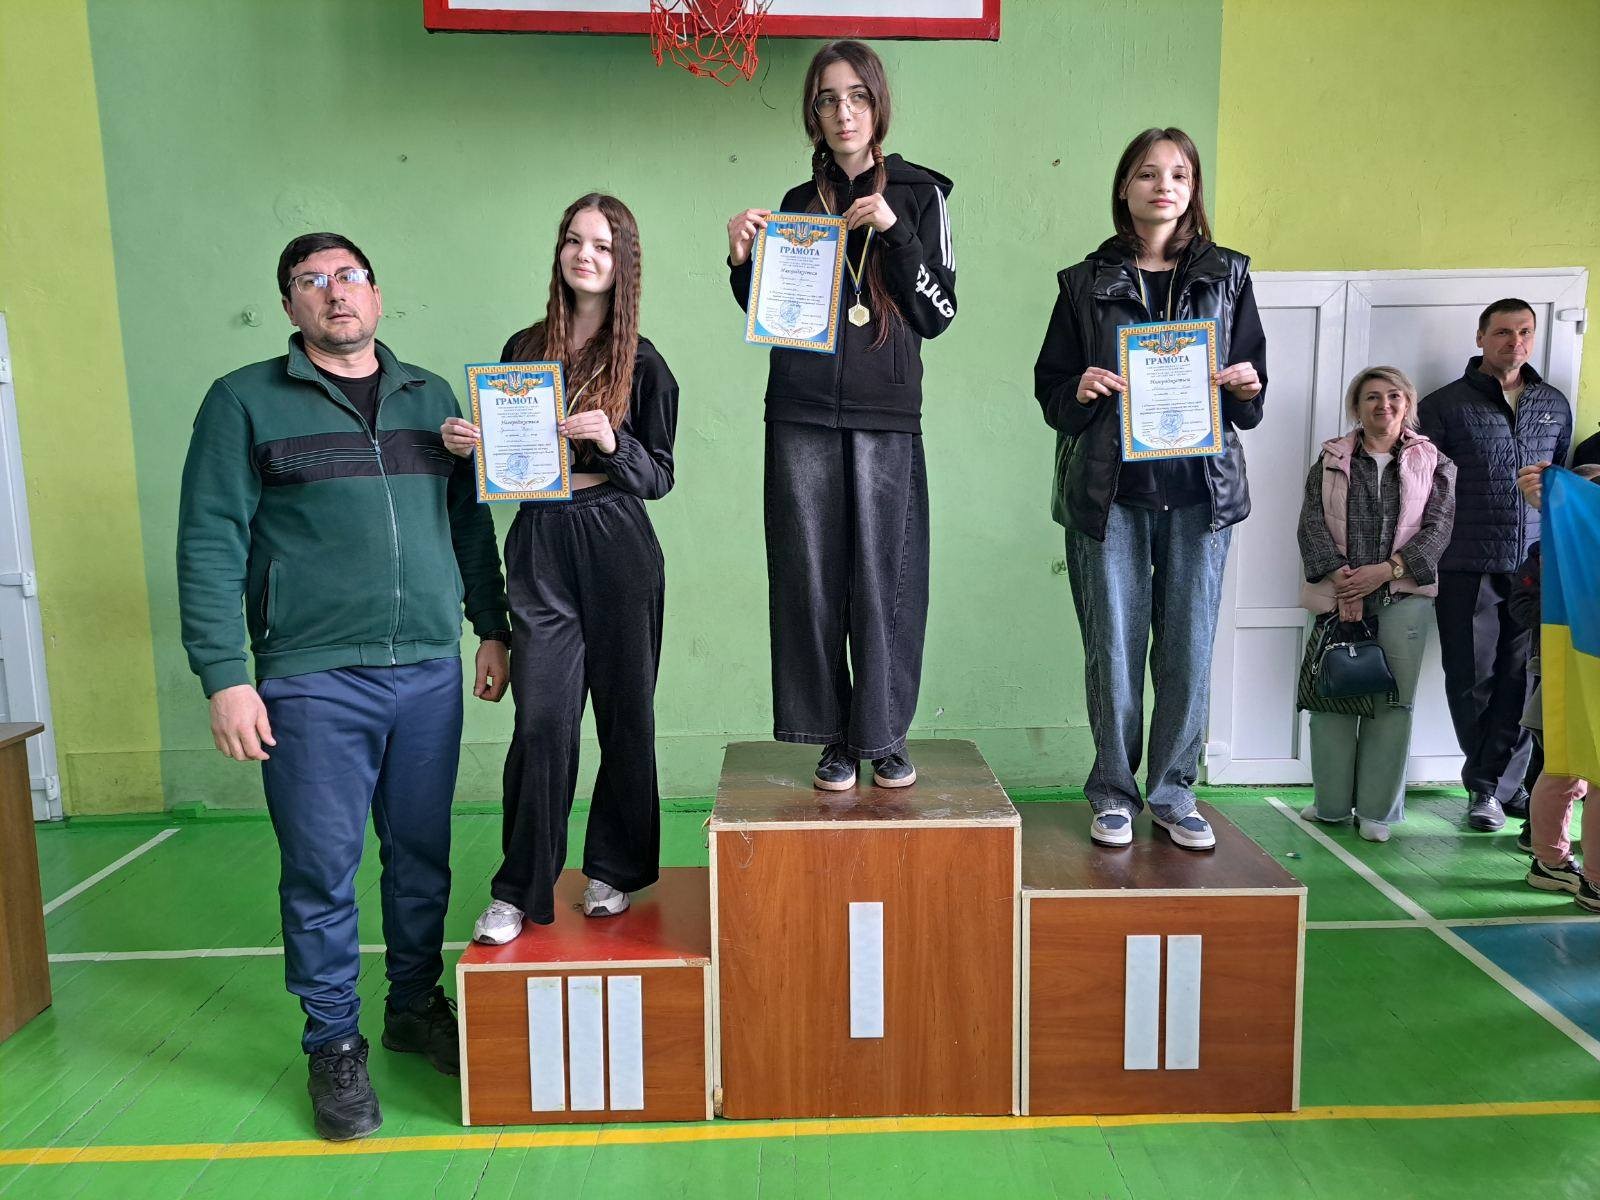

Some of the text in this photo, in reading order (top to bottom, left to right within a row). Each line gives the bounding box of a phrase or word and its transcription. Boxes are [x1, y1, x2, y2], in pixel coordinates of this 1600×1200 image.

[780, 246, 820, 256] ГРАМОТА
[1145, 355, 1190, 366] ГРАМОТА
[495, 397, 538, 405] ГРАМОТА
[1124, 935, 1202, 1070] II
[527, 975, 644, 1112] III
